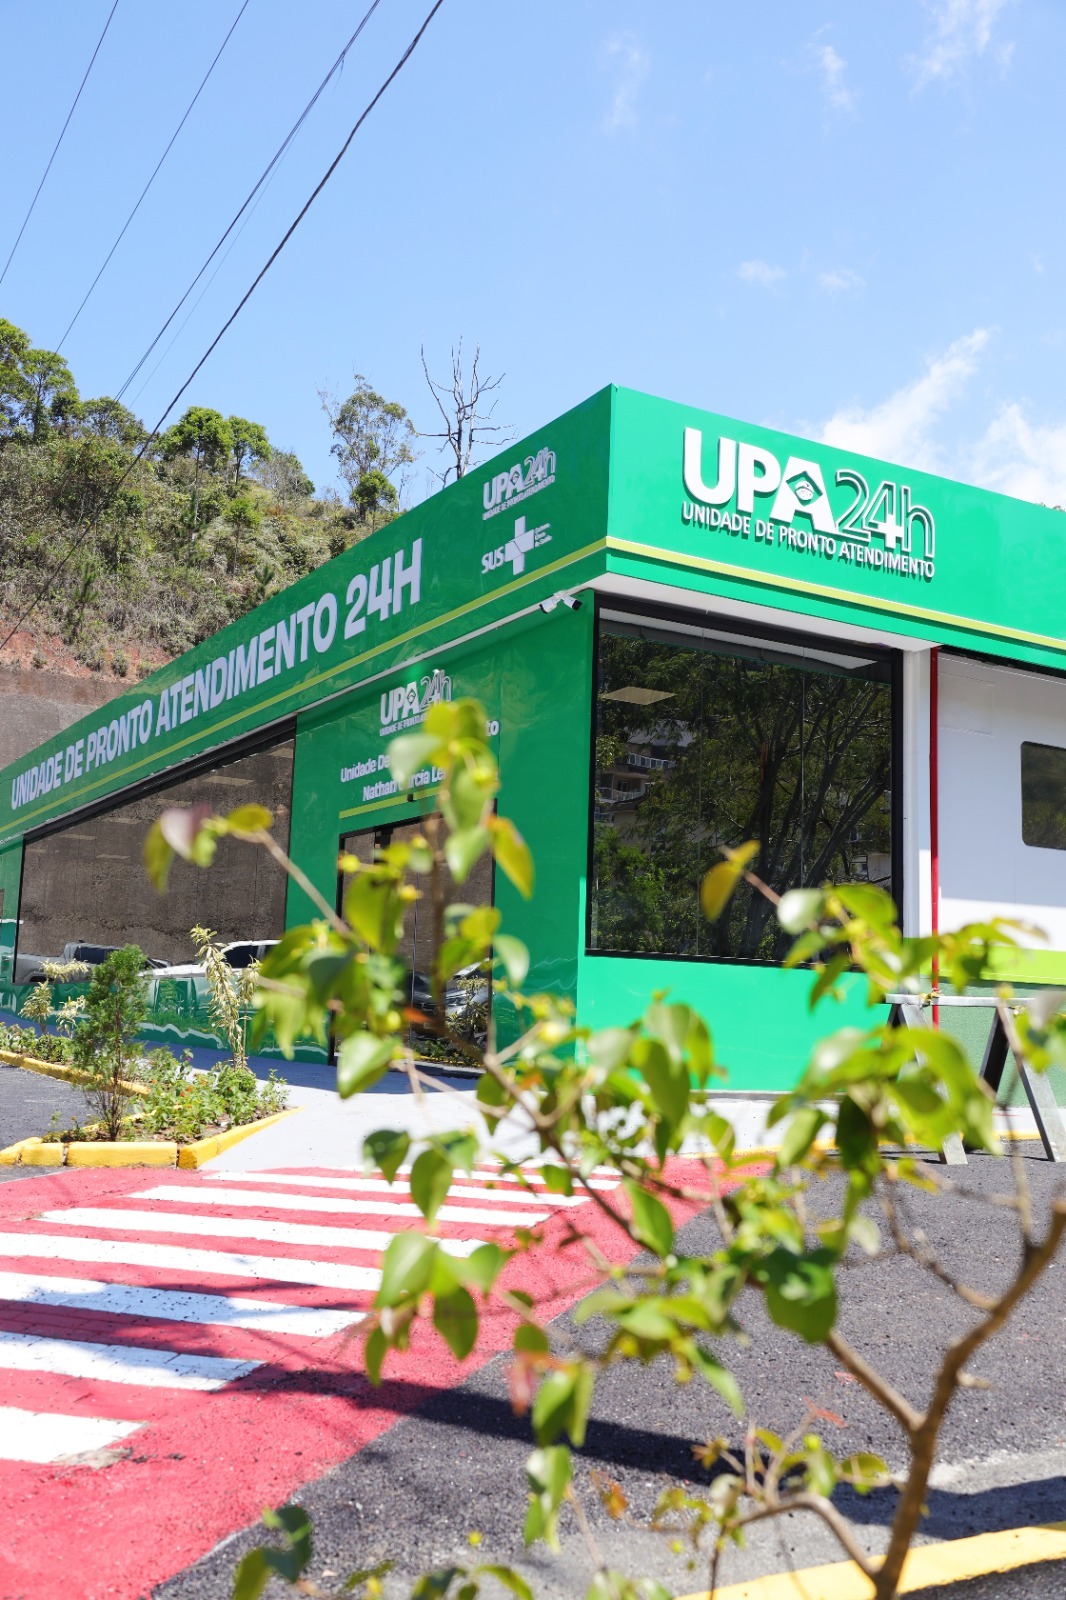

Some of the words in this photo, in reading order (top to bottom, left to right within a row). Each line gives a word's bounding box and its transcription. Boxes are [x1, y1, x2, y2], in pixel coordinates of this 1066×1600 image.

[681, 501, 751, 535] UNIDADE
[755, 519, 775, 541] DE
[778, 526, 836, 556] PRONTO
[838, 541, 936, 579] ATENDIMENTO
[481, 546, 506, 574] SUS
[11, 751, 63, 810] UNIDADE
[64, 738, 85, 784] DE
[86, 700, 153, 773] PRONTO
[155, 592, 338, 737] ATENDIMENTO
[344, 537, 423, 640] 24H
[340, 757, 376, 782] Unidade
[362, 780, 398, 801] Nathan
